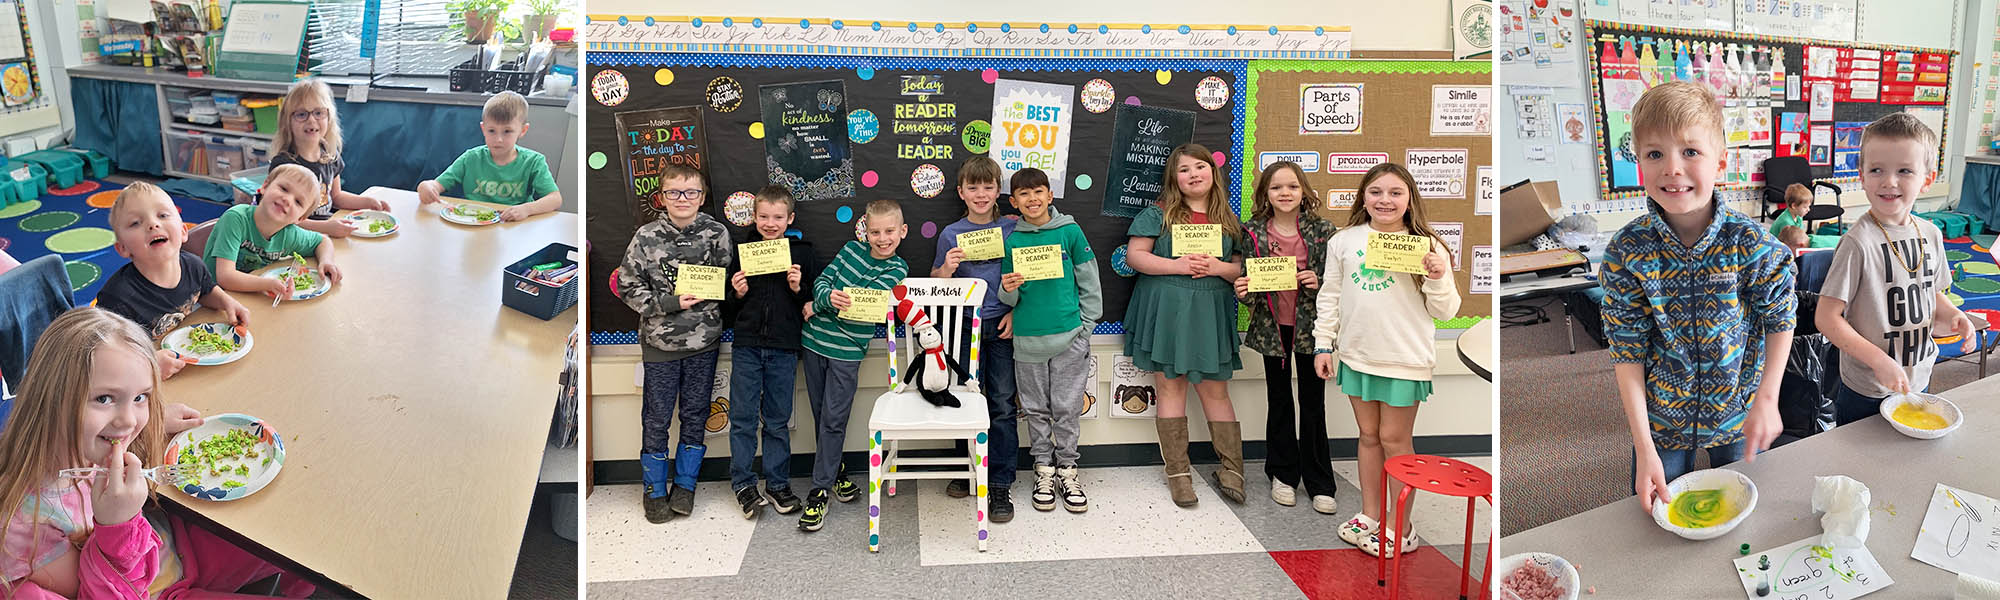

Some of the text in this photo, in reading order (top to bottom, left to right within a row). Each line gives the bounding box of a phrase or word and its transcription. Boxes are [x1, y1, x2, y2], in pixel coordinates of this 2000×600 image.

[1650, 8, 1672, 19] three
[1680, 10, 1694, 20] four
[597, 74, 617, 86] TODAY
[901, 75, 943, 94] Today
[1204, 81, 1220, 90] MAKE
[716, 82, 732, 94] STAY
[602, 88, 622, 102] DAY
[712, 90, 740, 108] Positive
[918, 94, 929, 102] a
[1314, 90, 1350, 102] Parts
[1448, 90, 1478, 100] Simile
[896, 104, 956, 118] READER
[1004, 104, 1060, 122] the BEST
[1324, 102, 1338, 114] of
[650, 119, 671, 127] Make
[848, 116, 873, 124] YOU'VE
[1307, 112, 1354, 126] Speech
[854, 122, 866, 134] got
[894, 120, 955, 135] tomorrow
[1138, 118, 1170, 136] Life
[922, 136, 932, 144] a
[968, 135, 986, 148] BIG
[1002, 121, 1059, 150] YOU
[642, 142, 684, 156] the day to
[898, 144, 953, 160] LEADER
[1130, 142, 1170, 156] MAKING
[1001, 150, 1056, 171] you BE!
[1126, 152, 1168, 166] MISTAKE
[1338, 156, 1378, 166] pronoun
[1409, 154, 1464, 166] Hyperbole
[1006, 161, 1022, 170] can
[1143, 168, 1149, 176] &
[472, 178, 524, 198] XBOX
[634, 177, 660, 196] SOM
[1122, 176, 1162, 194] Learnin
[1120, 196, 1142, 206] FROM
[1340, 192, 1357, 200] adv
[963, 228, 994, 239] ROCKSTAR
[1378, 233, 1421, 243] ROCKSTAR
[746, 240, 781, 249] ROCKSTAR
[968, 236, 991, 245] READER!
[752, 248, 777, 256] READER!
[1020, 246, 1053, 255] ROCKSTAR
[1383, 242, 1416, 252] READER!
[1025, 254, 1050, 262] READER!
[1881, 238, 1933, 283] I'VE
[686, 266, 718, 274] ROCKSTAR
[1362, 276, 1396, 292] LUCKY
[851, 288, 882, 296] ROCKSTAR
[908, 286, 929, 297] Mrs.
[854, 296, 878, 304] READER!
[1887, 281, 1933, 327] GOT
[1884, 326, 1936, 366] THIS
[1782, 556, 1822, 587] green
[1819, 585, 1834, 600] 2
